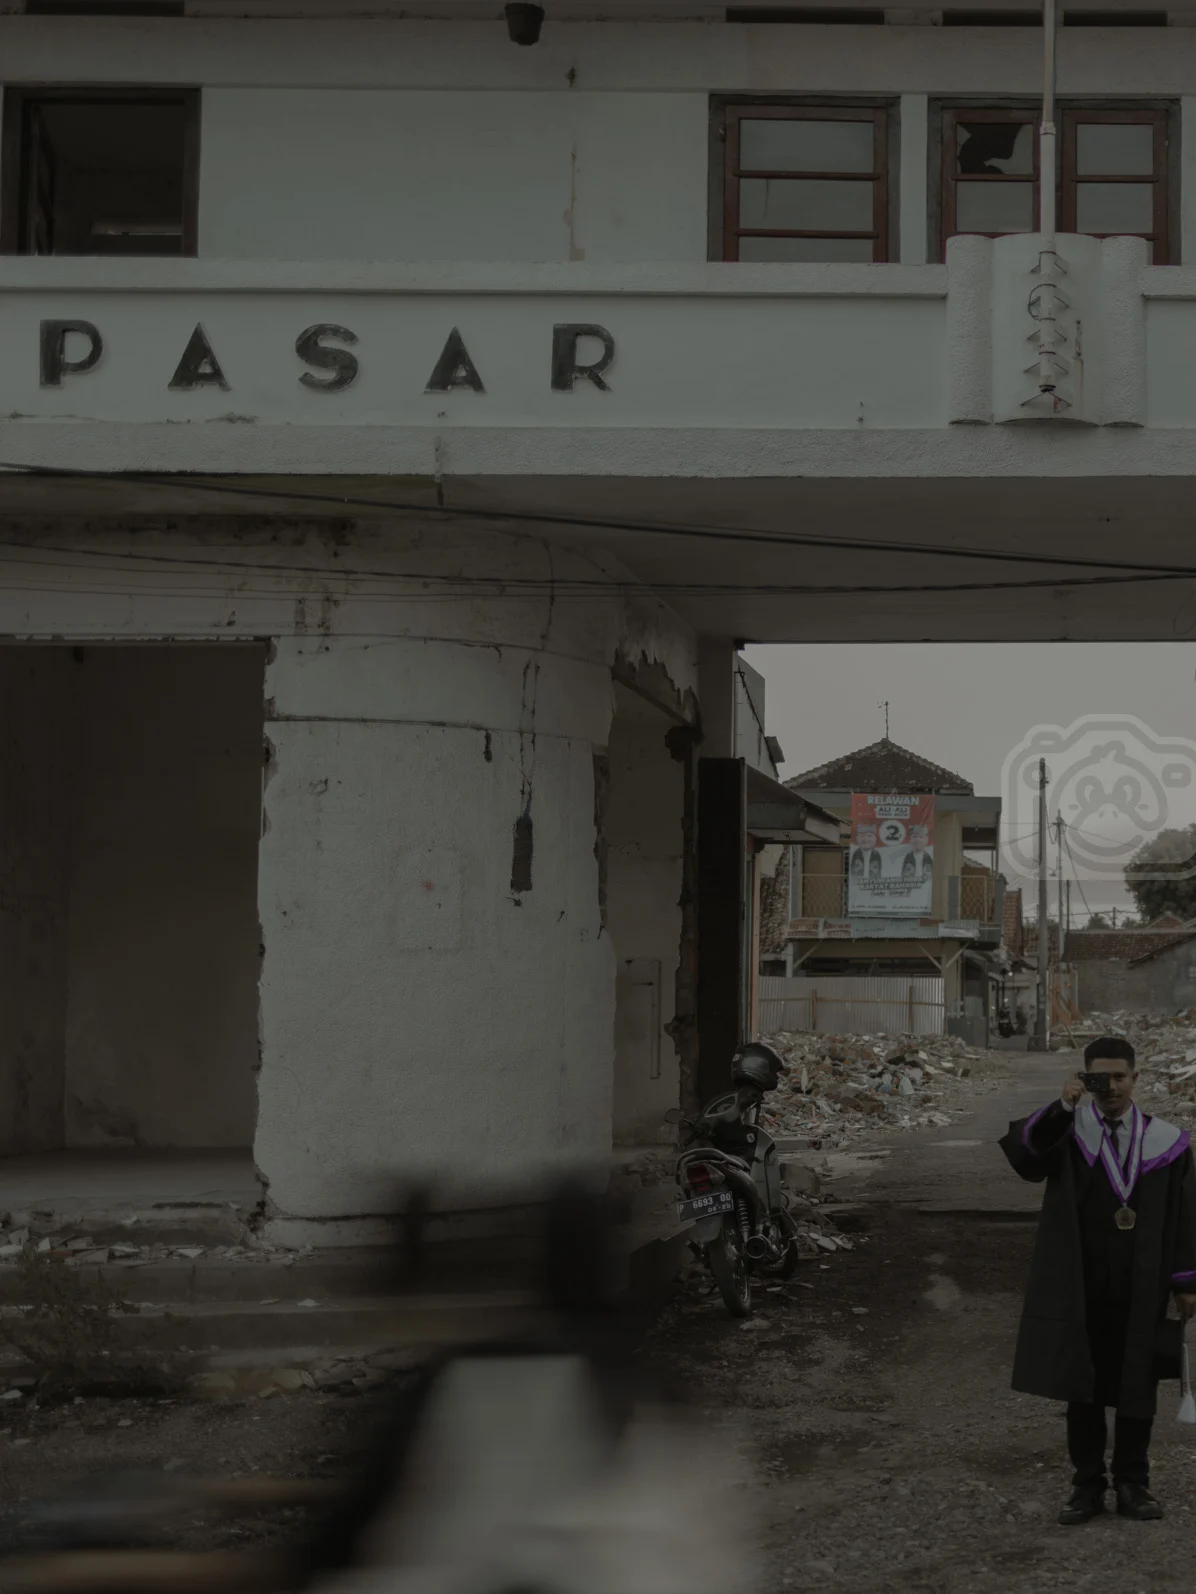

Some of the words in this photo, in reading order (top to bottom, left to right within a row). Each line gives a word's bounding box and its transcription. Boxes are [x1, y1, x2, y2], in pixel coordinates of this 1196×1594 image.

[40, 319, 616, 393] PASAR
[867, 795, 920, 806] RELAWAN
[885, 825, 900, 841] 2
[679, 1204, 684, 1213] P
[692, 1197, 713, 1209] 6693
